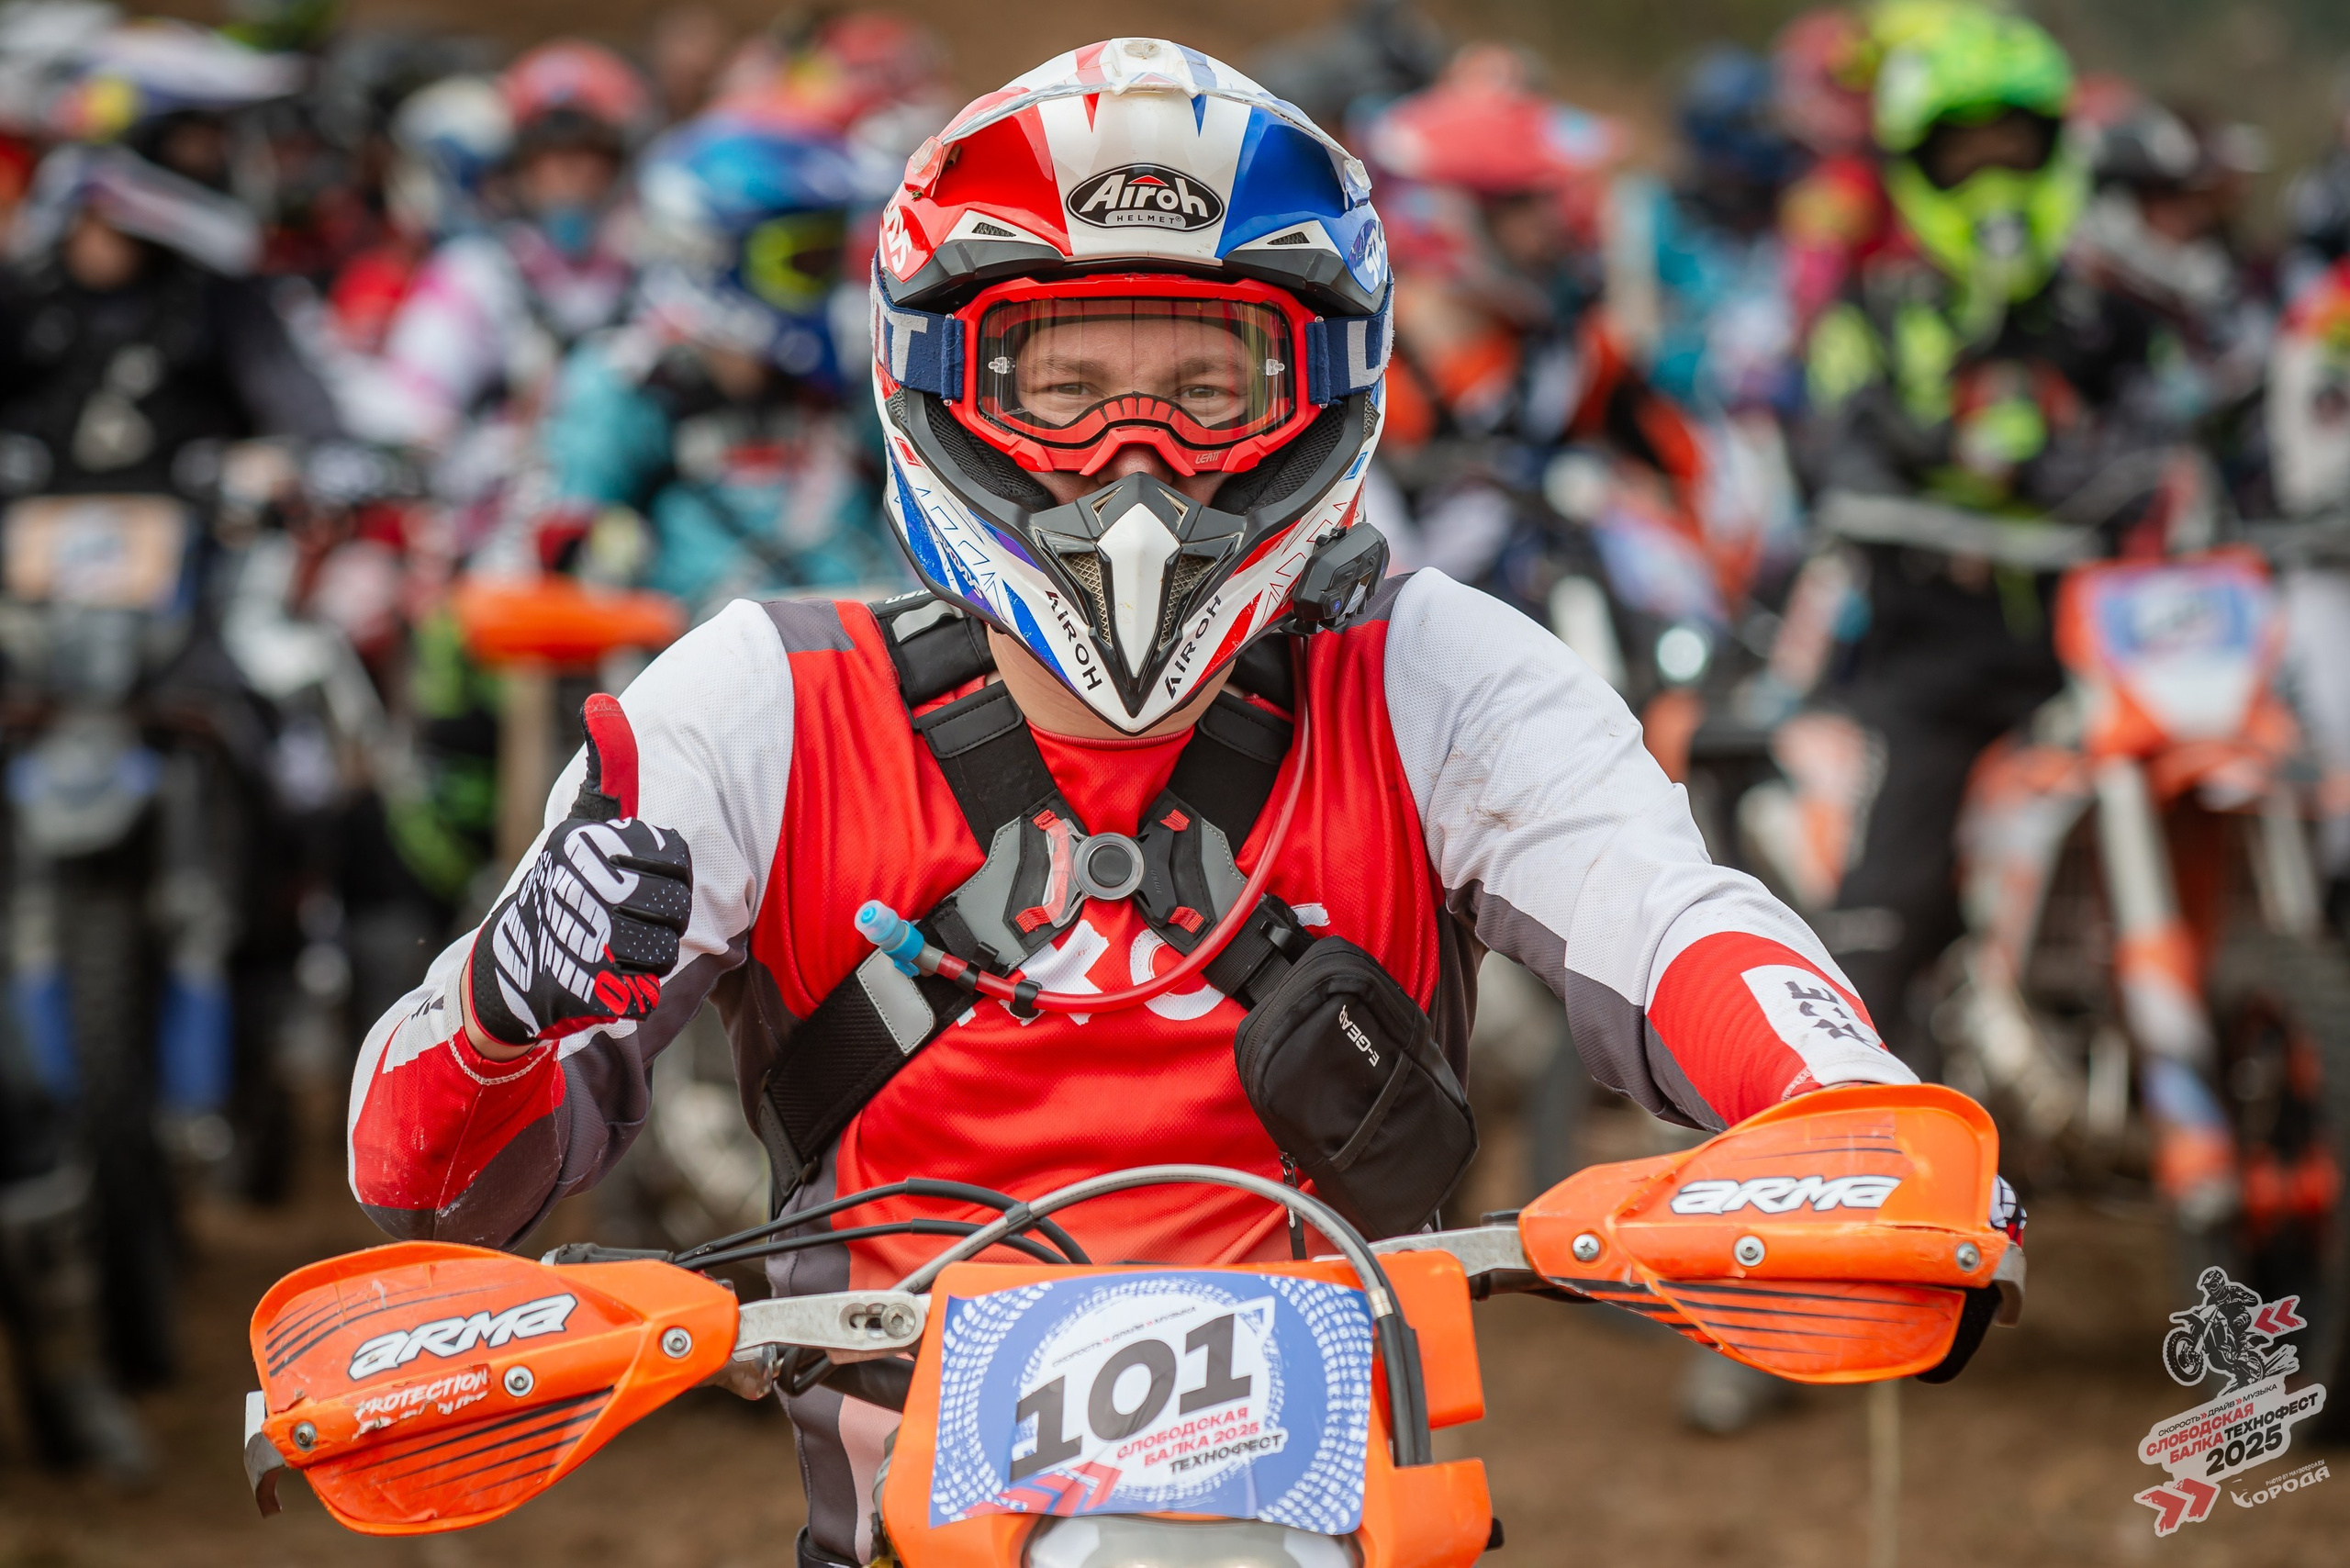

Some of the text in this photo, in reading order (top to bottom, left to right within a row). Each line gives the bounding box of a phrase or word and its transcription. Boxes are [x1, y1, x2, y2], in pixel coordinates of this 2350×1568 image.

[1079, 174, 1208, 218] Airoh
[1045, 589, 1102, 691] AIROH
[1164, 595, 1223, 700] AIROH
[1337, 1004, 1381, 1067] E-GEAR
[354, 1368, 489, 1420] PROTECTION
[1010, 1313, 1252, 1483] 101
[1116, 1406, 1249, 1460] СЛОБОДСКАЯ
[1144, 1435, 1210, 1467] БАЛКА
[1169, 1434, 1282, 1475] ТЕХНОФЕСТ
